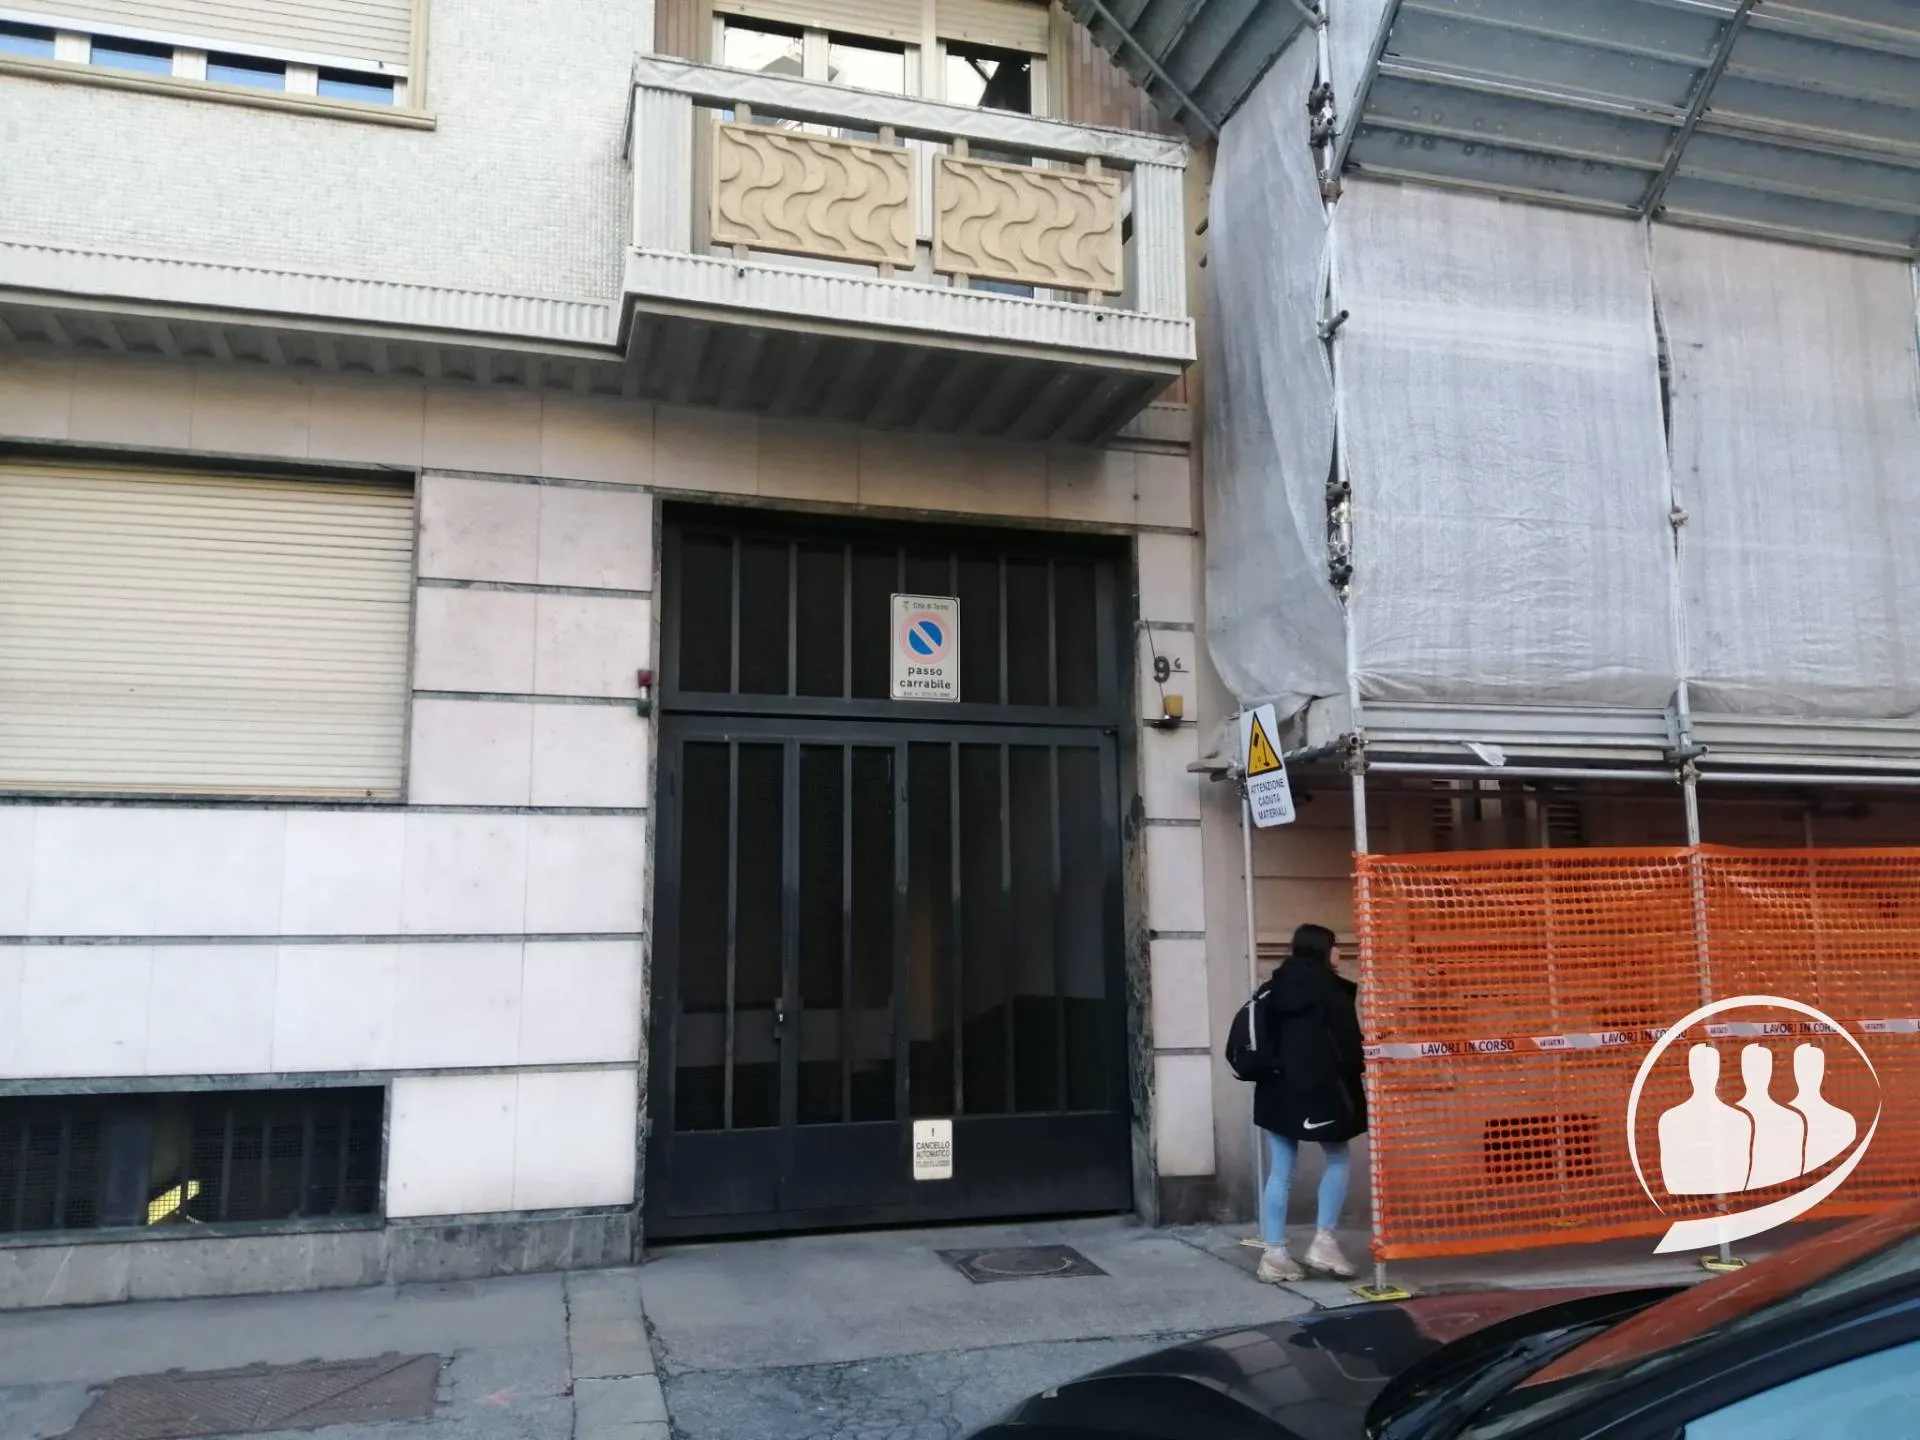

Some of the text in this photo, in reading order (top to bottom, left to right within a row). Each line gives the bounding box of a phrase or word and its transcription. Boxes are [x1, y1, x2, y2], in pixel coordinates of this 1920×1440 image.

[908, 667, 942, 676] passo
[899, 679, 951, 690] carrabile
[1250, 778, 1285, 794] ATTENZIONE
[1257, 794, 1281, 807] CADUTA
[1257, 807, 1287, 820] MATERIALI
[1763, 1023, 1797, 1034] LAVORI
[1799, 1023, 1810, 1033] IN
[1601, 1031, 1638, 1044] LAVORI
[1641, 1030, 1652, 1041] IN
[1421, 1039, 1515, 1055] LAVORI IN CORSO
[916, 1141, 950, 1150] CANCELLO
